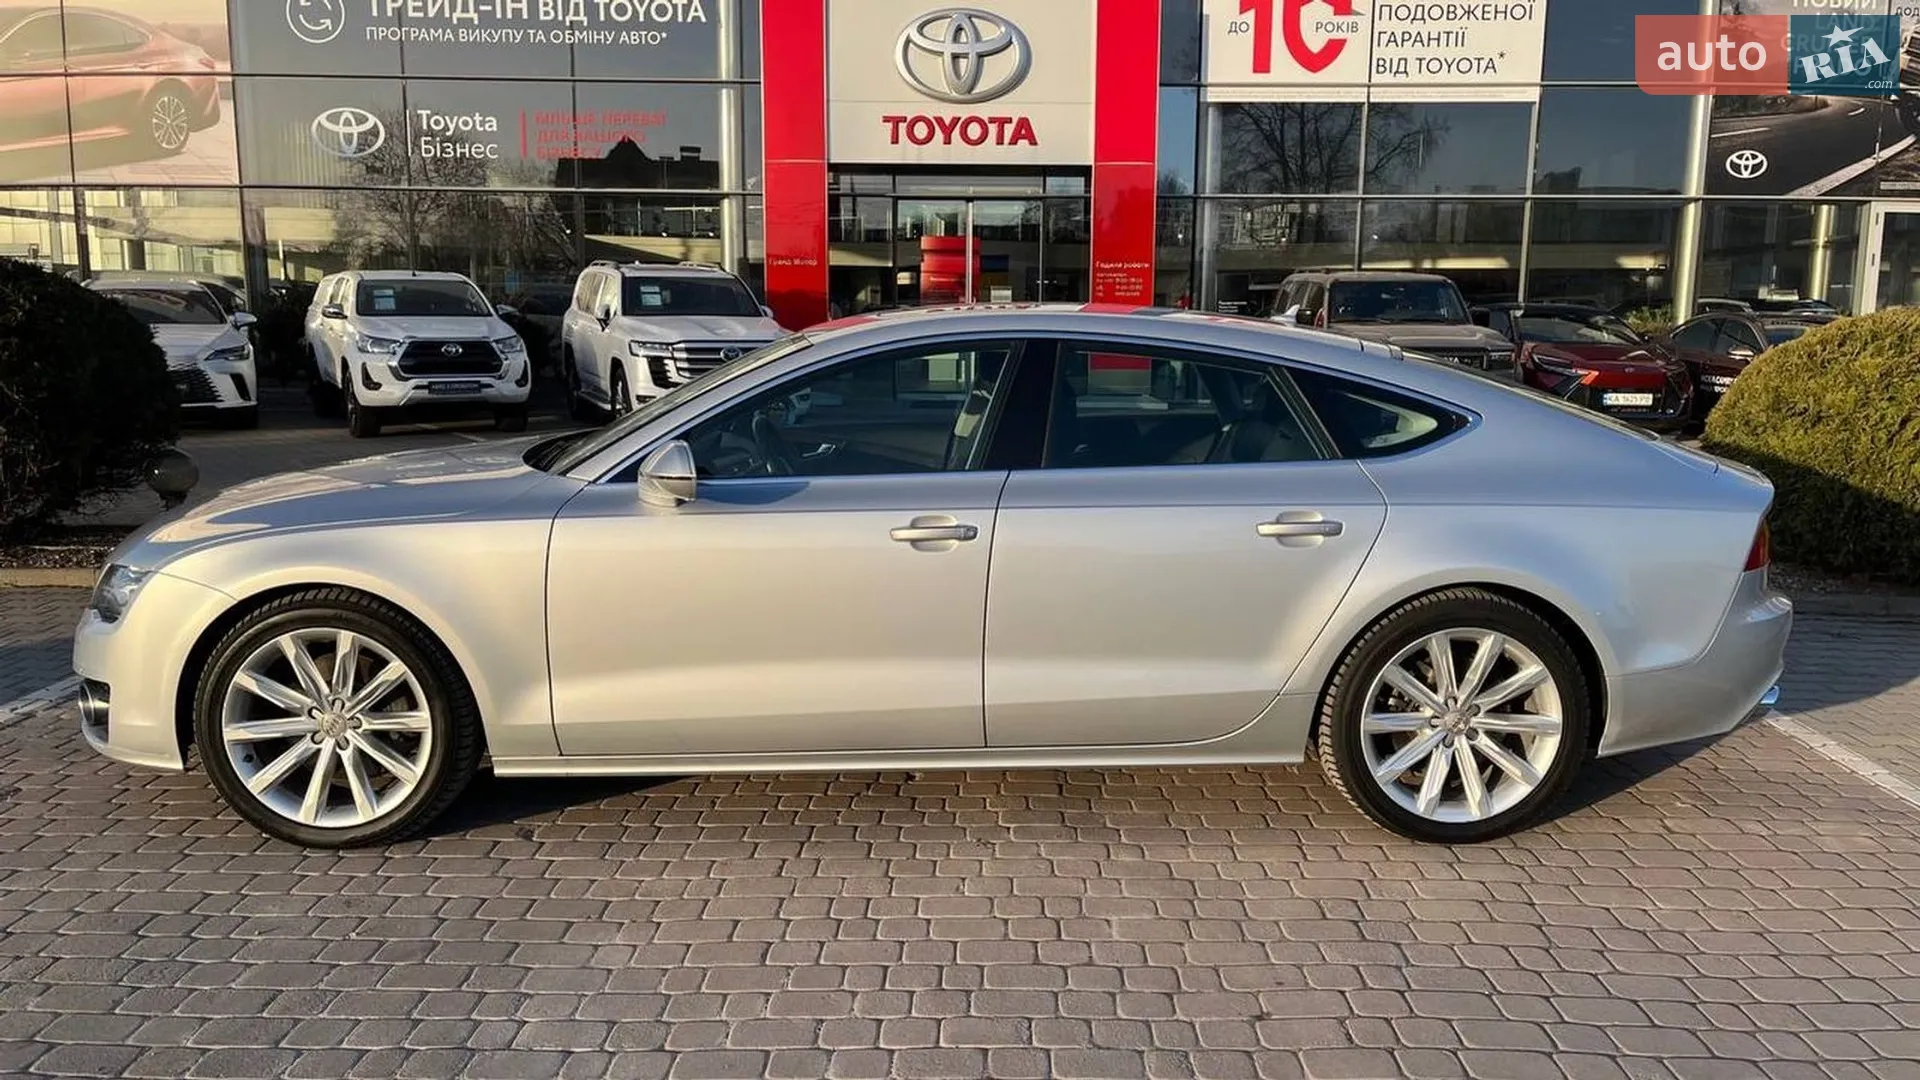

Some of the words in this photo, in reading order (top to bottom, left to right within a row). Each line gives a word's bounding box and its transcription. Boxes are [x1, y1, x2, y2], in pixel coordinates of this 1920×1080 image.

[539, 0, 587, 26] ВІД
[594, 0, 707, 22] TOYOTA
[1378, 0, 1536, 24] ПОДОВЖЕНОЇ
[366, 27, 454, 42] ПРОГРАМА
[459, 28, 523, 43] ВИКУПУ
[527, 29, 546, 43] ТА
[550, 30, 615, 44] ОБМІНУ
[1227, 21, 1250, 34] ДО
[1315, 21, 1359, 33] РОКІВ
[1377, 26, 1468, 47] ГАРАНТІЇ
[1376, 57, 1409, 77] ВІД
[417, 110, 498, 136] Toyota
[882, 115, 1038, 146] TOYOTA
[421, 137, 499, 159] Бізнес
